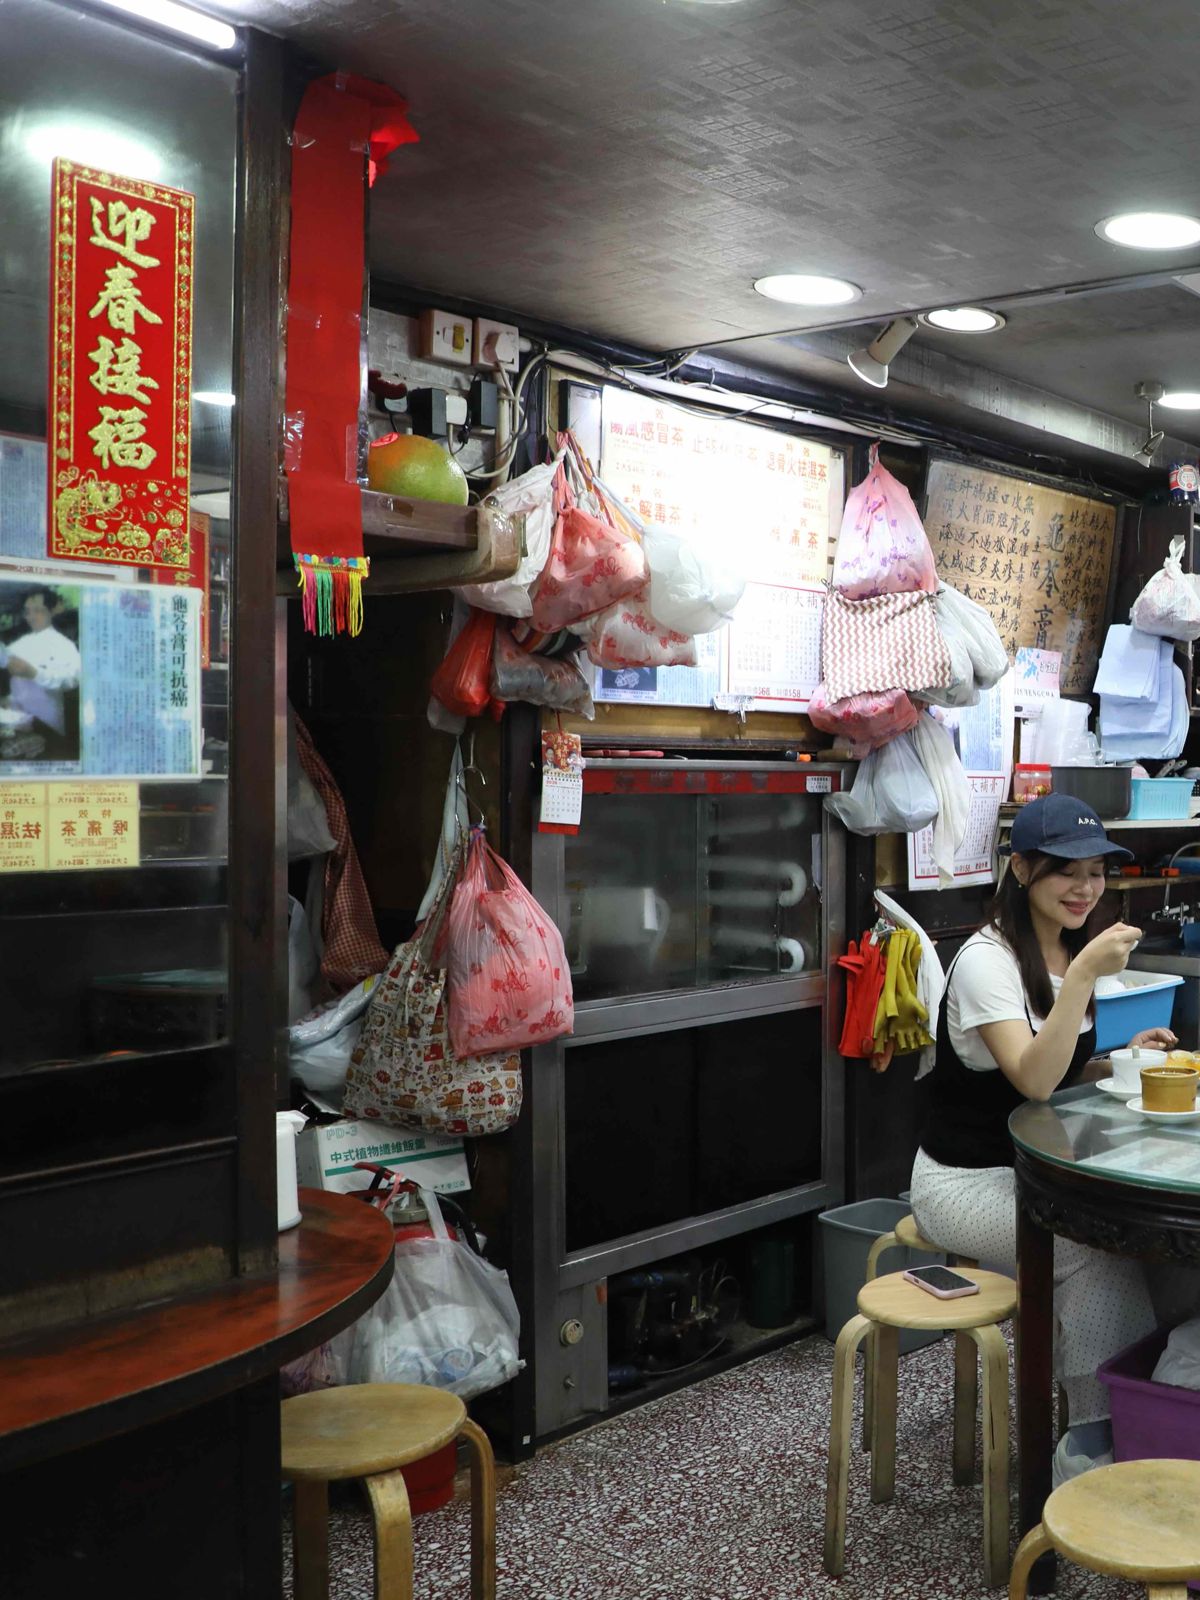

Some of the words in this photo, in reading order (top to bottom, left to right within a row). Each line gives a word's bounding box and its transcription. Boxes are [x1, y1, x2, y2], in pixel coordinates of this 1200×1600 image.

[87, 195, 163, 470] 迎春接福
[1078, 817, 1098, 826] A.P.C.
[326, 1125, 358, 1140] PD-3
